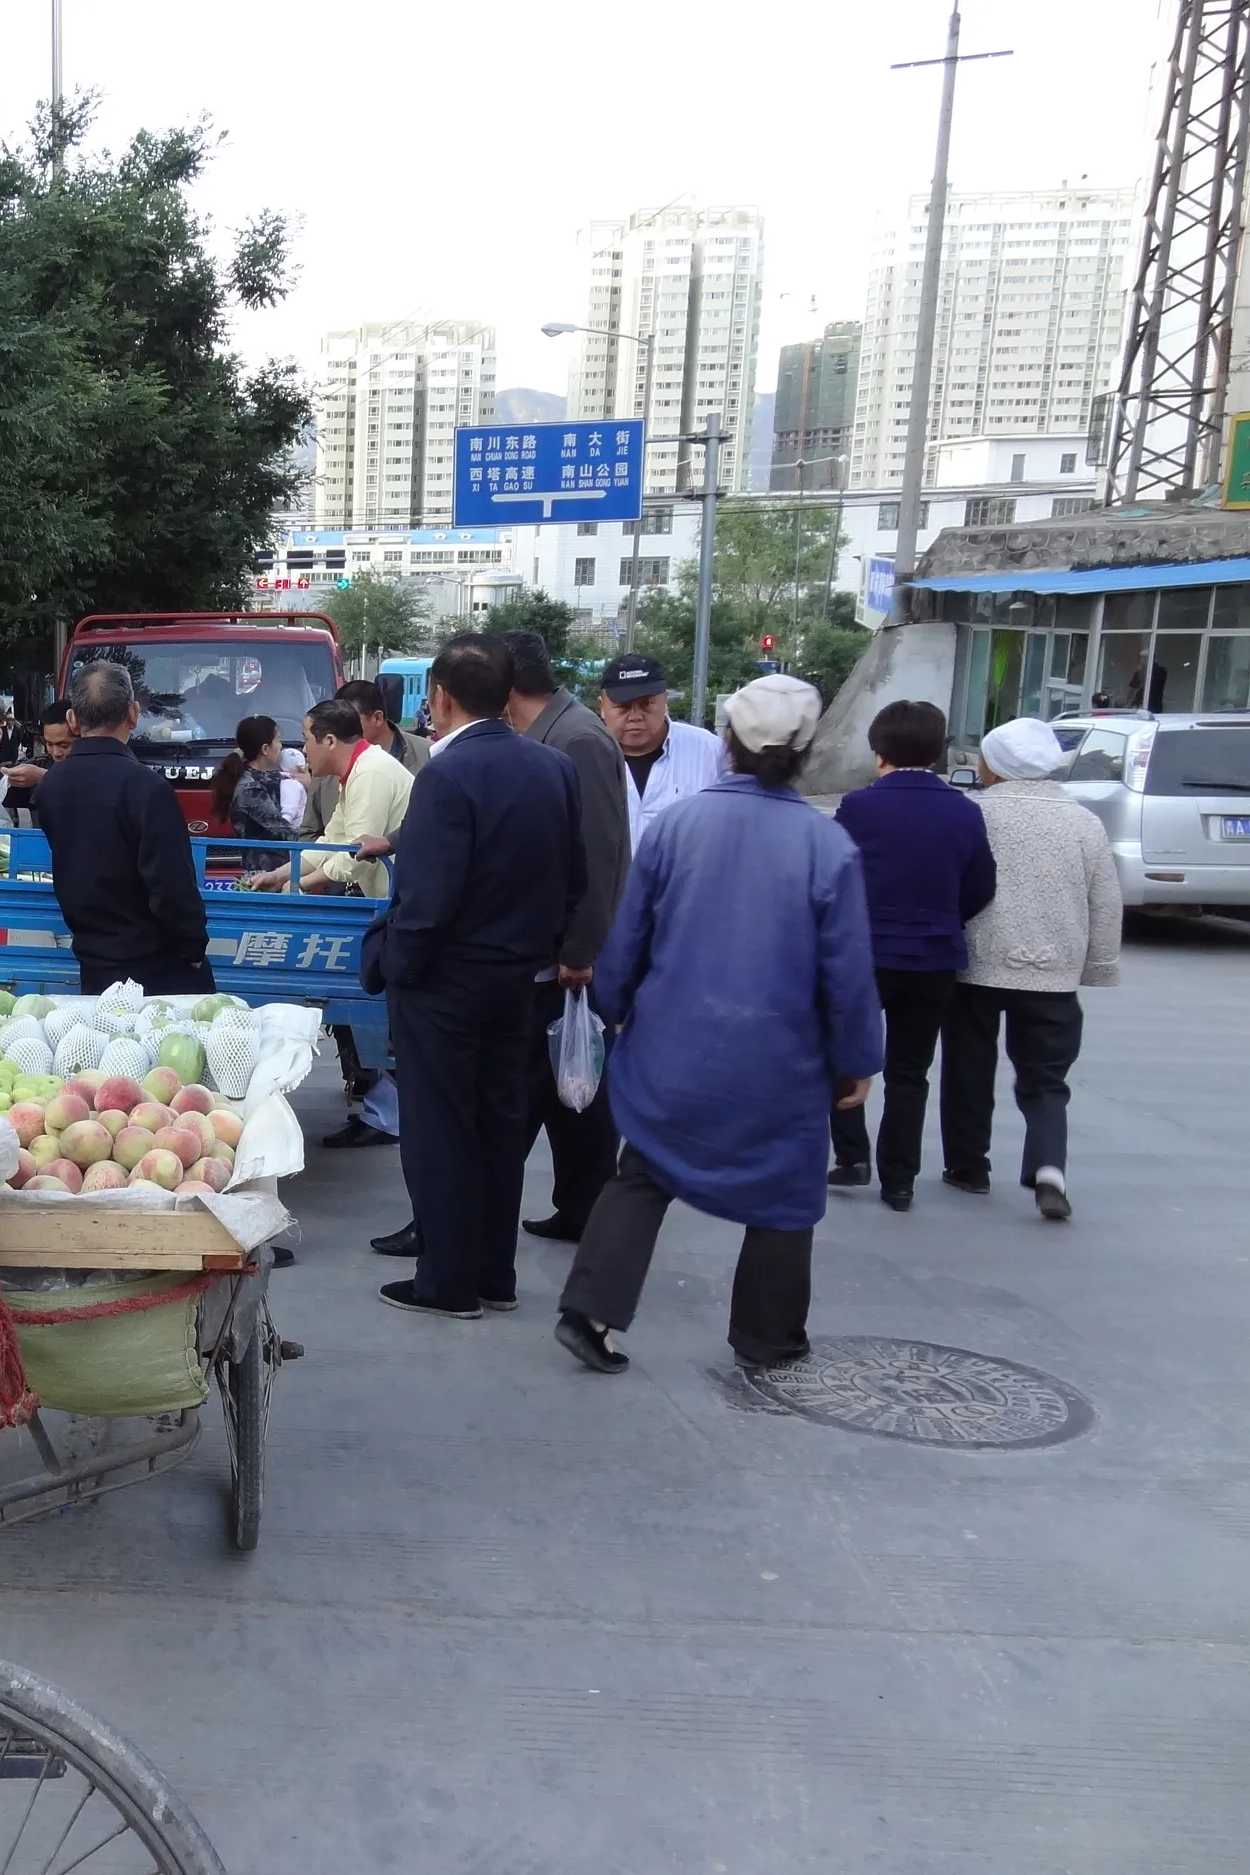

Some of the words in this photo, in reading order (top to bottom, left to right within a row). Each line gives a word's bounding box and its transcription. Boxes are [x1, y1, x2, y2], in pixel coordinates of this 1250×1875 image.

[470, 434, 537, 452] 南川东路
[563, 430, 630, 448] 南大街
[470, 453, 482, 462] NAN
[504, 450, 519, 460] DONG
[521, 450, 536, 460] ROAD
[560, 448, 577, 458] NAN
[590, 447, 601, 457] DA
[616, 445, 629, 456] JIE
[470, 466, 535, 481] 西塔高速
[562, 462, 628, 479] 南山公园
[472, 483, 480, 492] XI
[489, 482, 498, 491] TA
[503, 481, 520, 491] GAO
[523, 480, 533, 490] SU
[561, 480, 576, 489] NAN
[578, 479, 594, 488] SHAN
[595, 478, 611, 487] GONG
[614, 477, 629, 486] YUAN
[232, 931, 355, 970] 摩托
